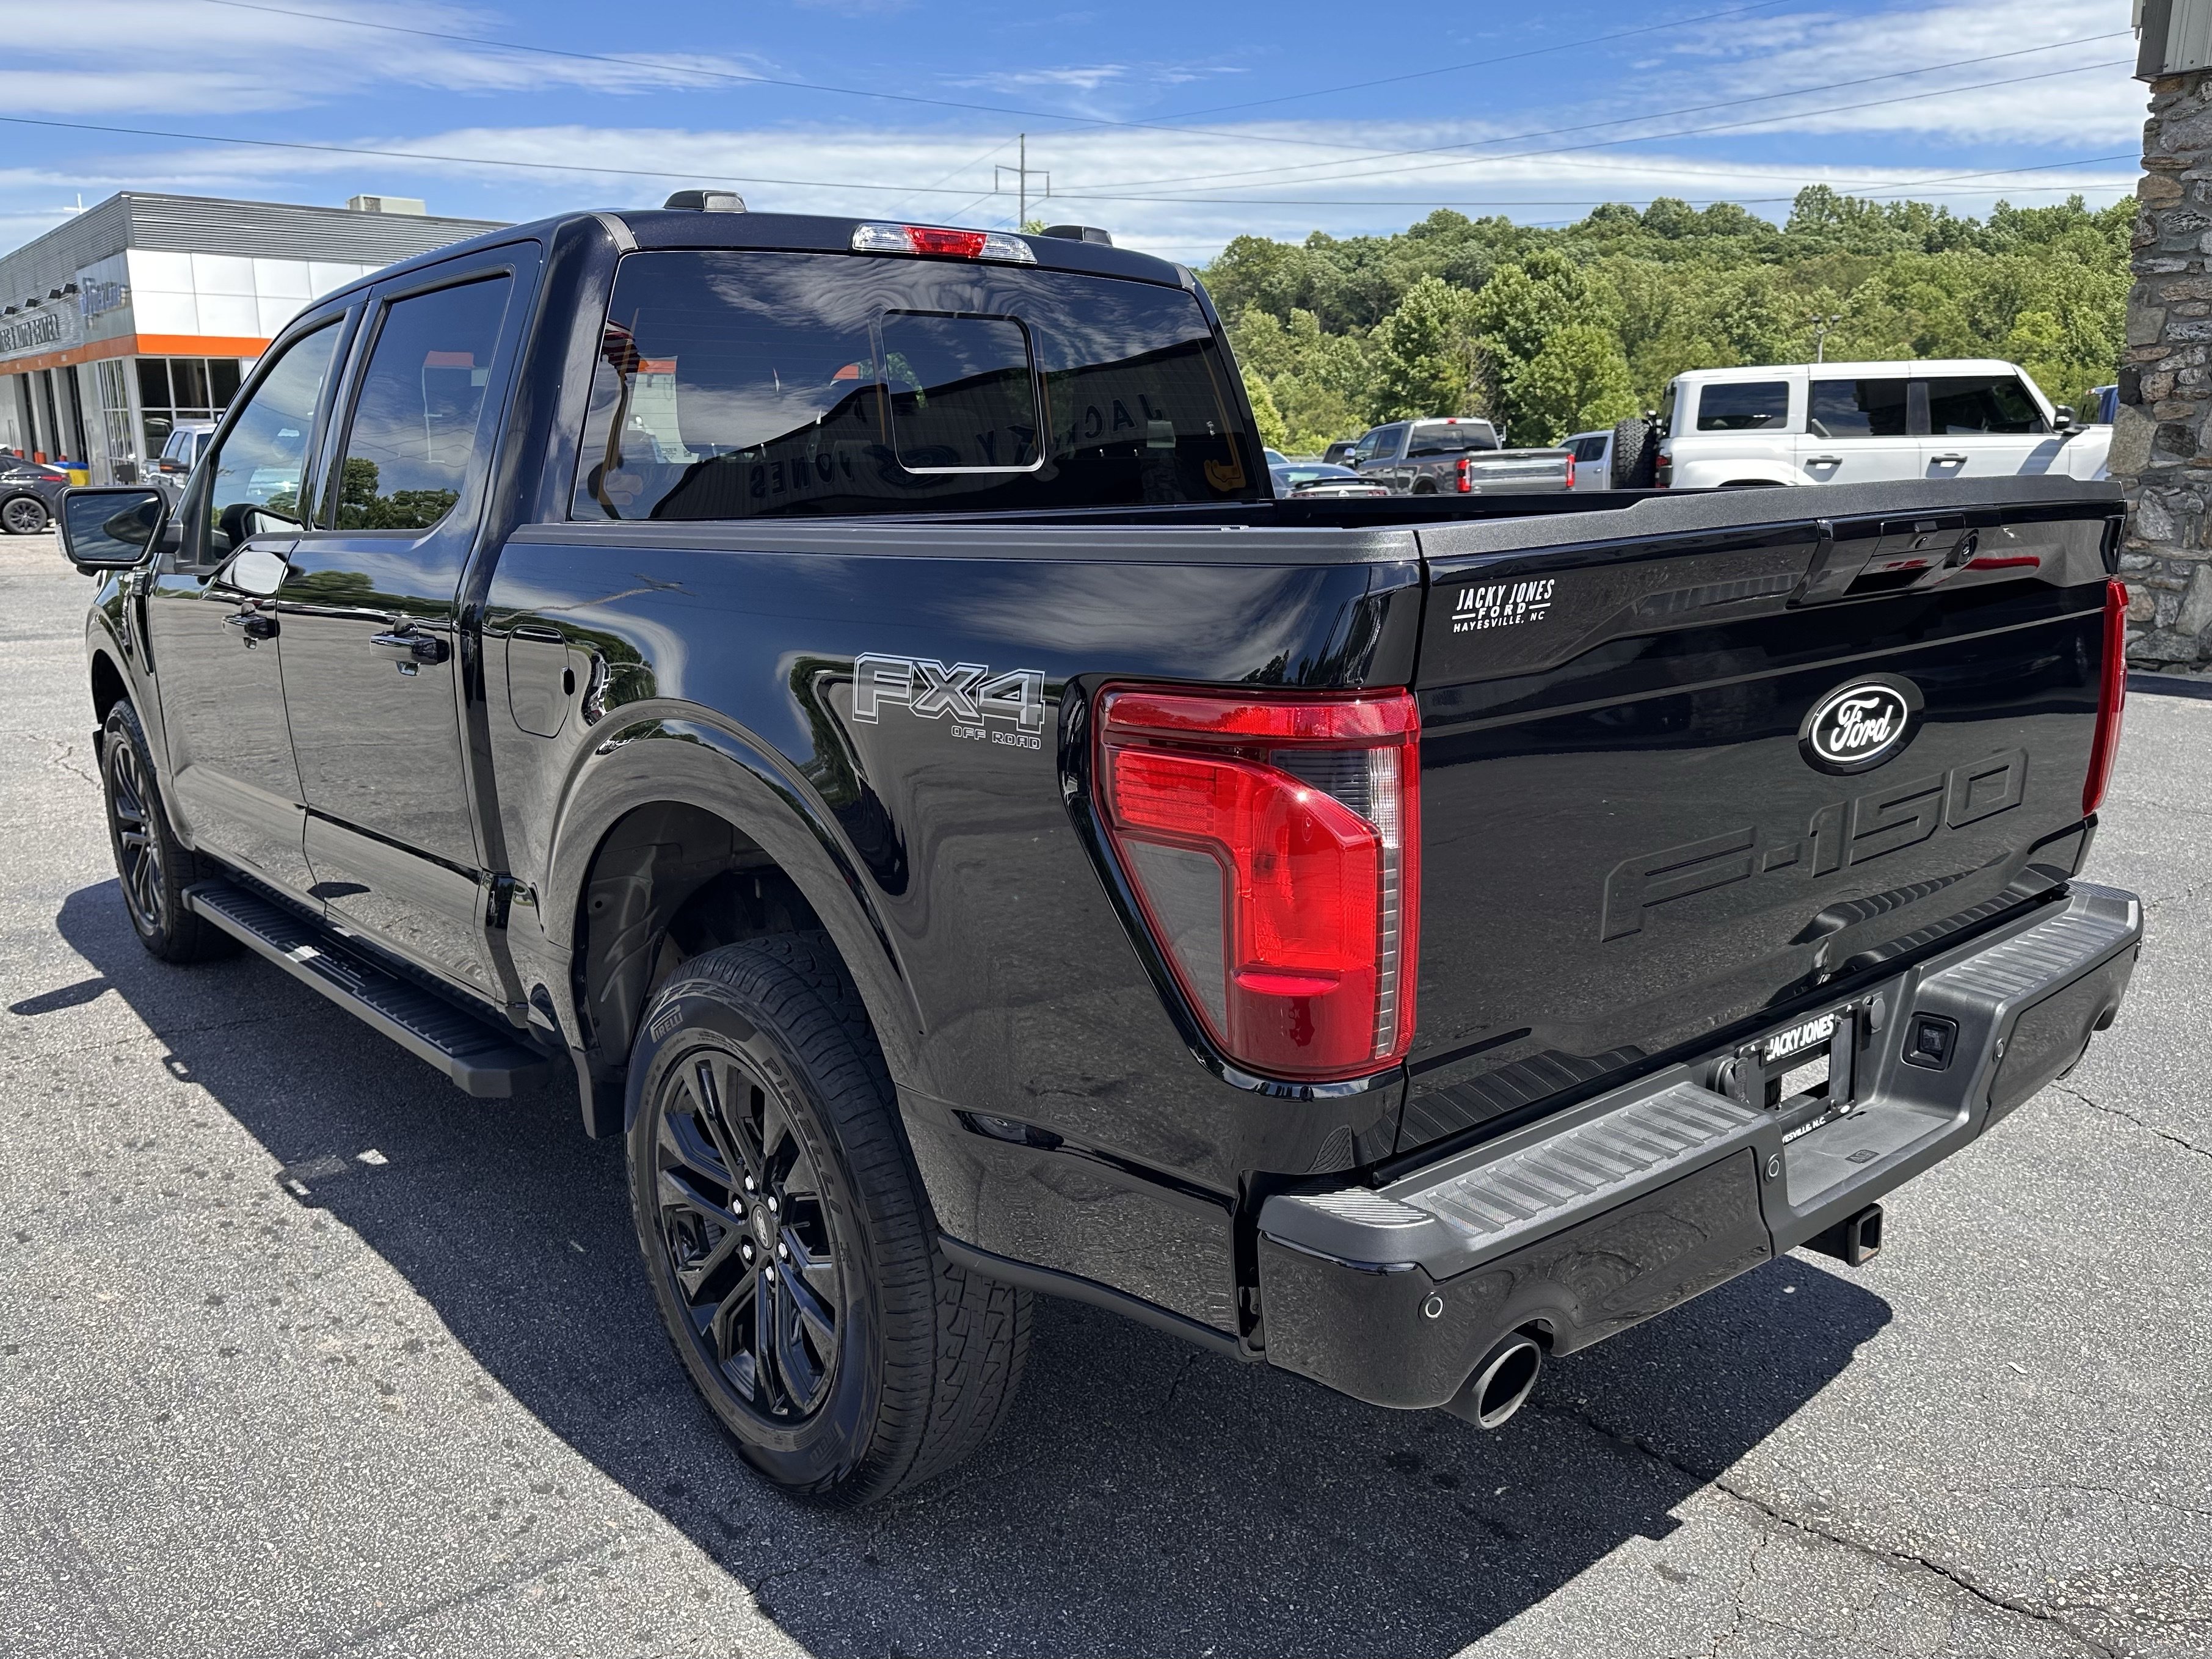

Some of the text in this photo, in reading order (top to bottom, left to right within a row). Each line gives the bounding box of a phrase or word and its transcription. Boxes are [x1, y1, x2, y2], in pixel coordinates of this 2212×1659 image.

[1456, 579, 1555, 611] JACKY JONES
[1478, 602, 1526, 620] FORD
[1453, 611, 1545, 633] HAYESVILLE, NC
[853, 652, 1046, 735] FX4
[951, 725, 1041, 750] OFF ROAD
[1830, 696, 1894, 752] Ford
[1599, 746, 2029, 943] F-150
[650, 1004, 683, 1044] PIRELLI
[1767, 1013, 1835, 1061] JACKY JONES
[762, 1056, 843, 1216] PIRELLI
